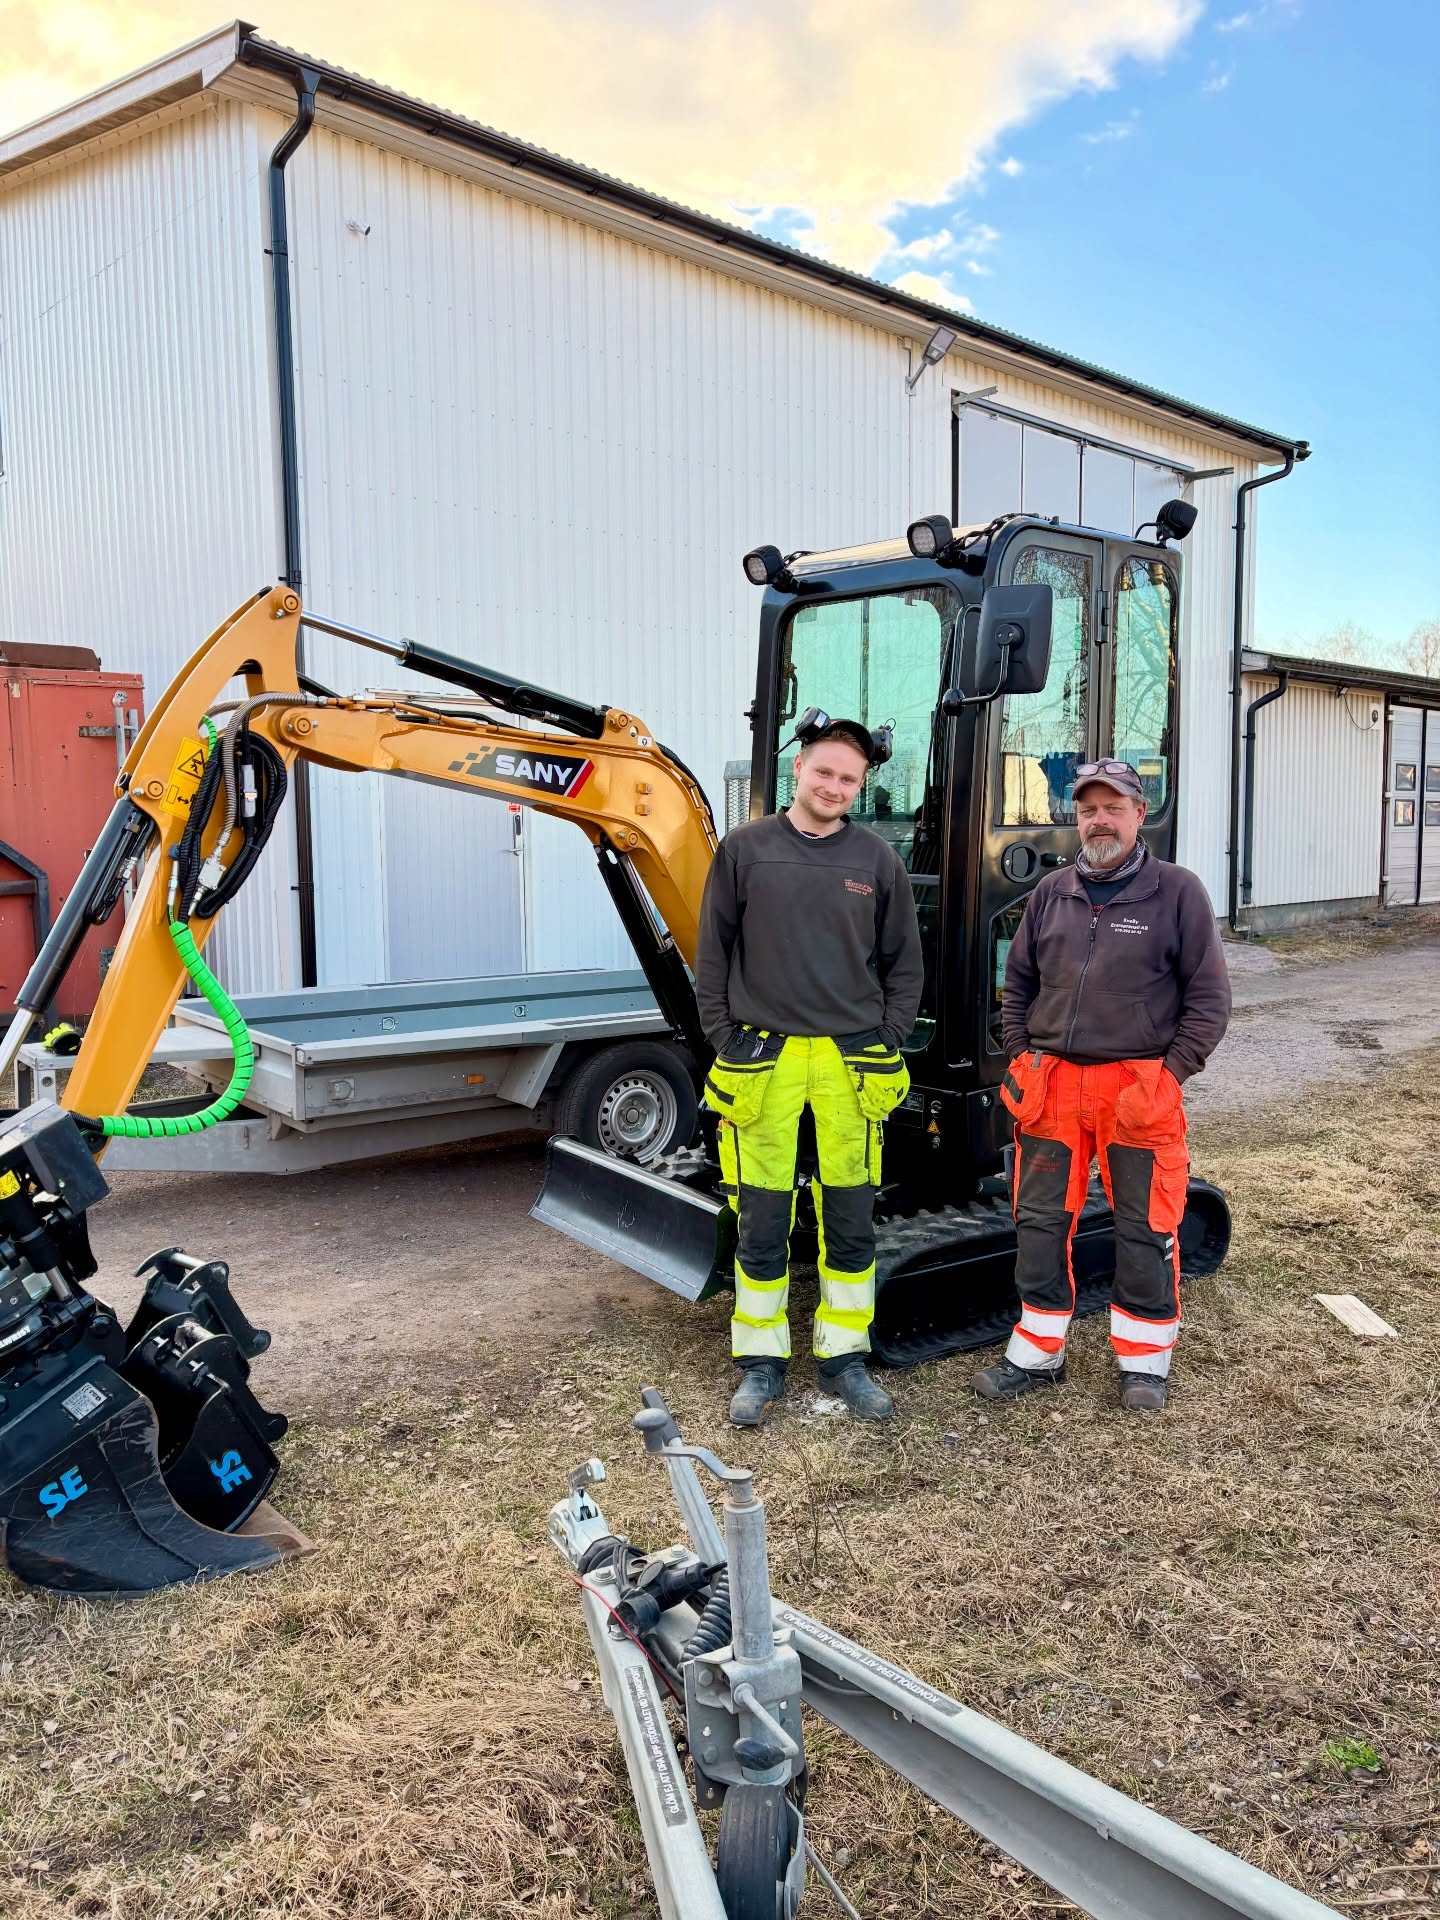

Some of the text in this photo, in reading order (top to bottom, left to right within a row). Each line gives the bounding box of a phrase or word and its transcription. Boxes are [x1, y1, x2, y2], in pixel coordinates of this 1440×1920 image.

[495, 754, 573, 786] SANY
[209, 1450, 253, 1494] SE
[39, 1464, 89, 1518] SE
[783, 1611, 819, 1636] KOPPLAD
[831, 1638, 861, 1660] VAGNEN
[860, 1654, 878, 1669] ATT
[877, 1664, 940, 1703] KONTROLLERA
[651, 1743, 663, 1758] UPP
[655, 1756, 667, 1771] DRA
[659, 1769, 671, 1784] ATT
[662, 1783, 674, 1793] EJ
[664, 1792, 680, 1814] GLÖM
